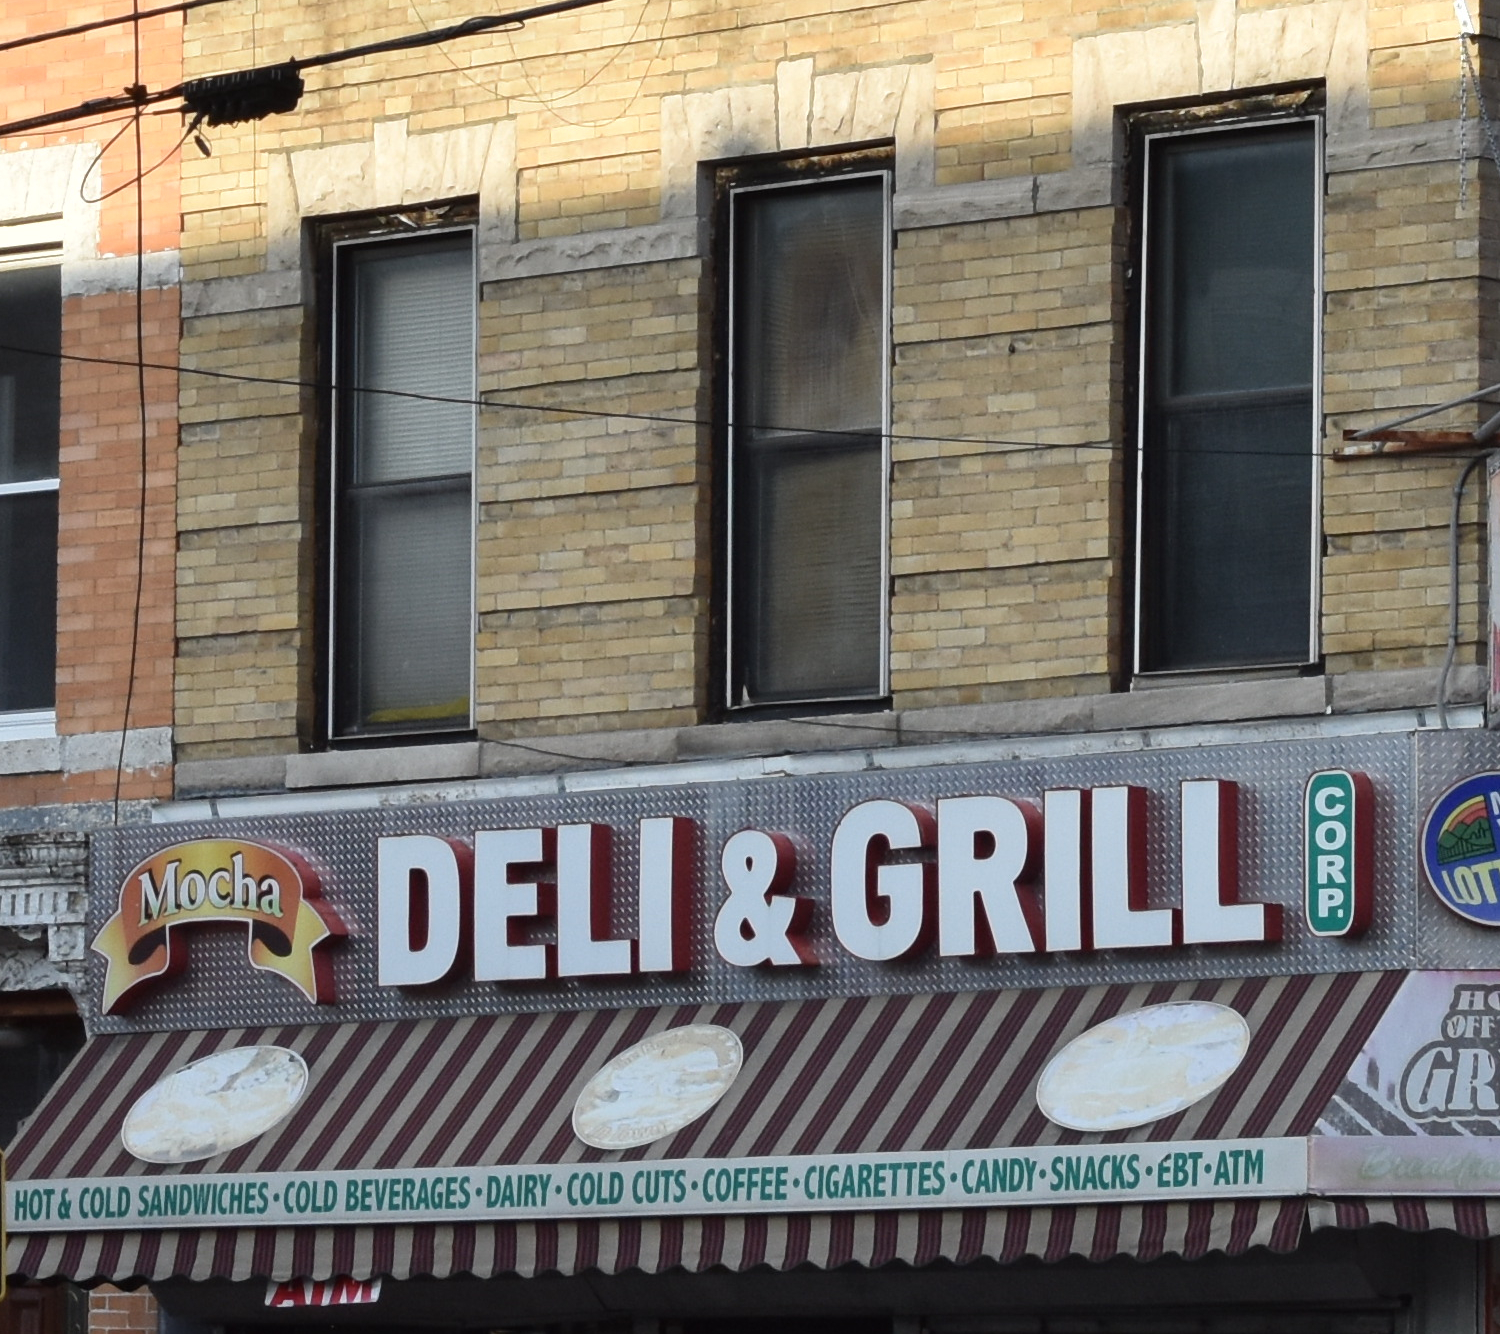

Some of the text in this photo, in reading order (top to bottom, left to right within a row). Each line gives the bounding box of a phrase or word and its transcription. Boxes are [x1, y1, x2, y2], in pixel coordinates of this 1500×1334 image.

[138, 851, 284, 926] Mocha
[378, 779, 1265, 986] DELI & GRILL
[1314, 786, 1347, 918] CORP.
[1447, 1015, 1497, 1039] OFF
[14, 1149, 1264, 1221] HOT & COLD SANDWICHES COLD BEVERAGES DAIRY COLD CUTS COFFEE CIGARETTES CANDY SNACKS EBT ATM
